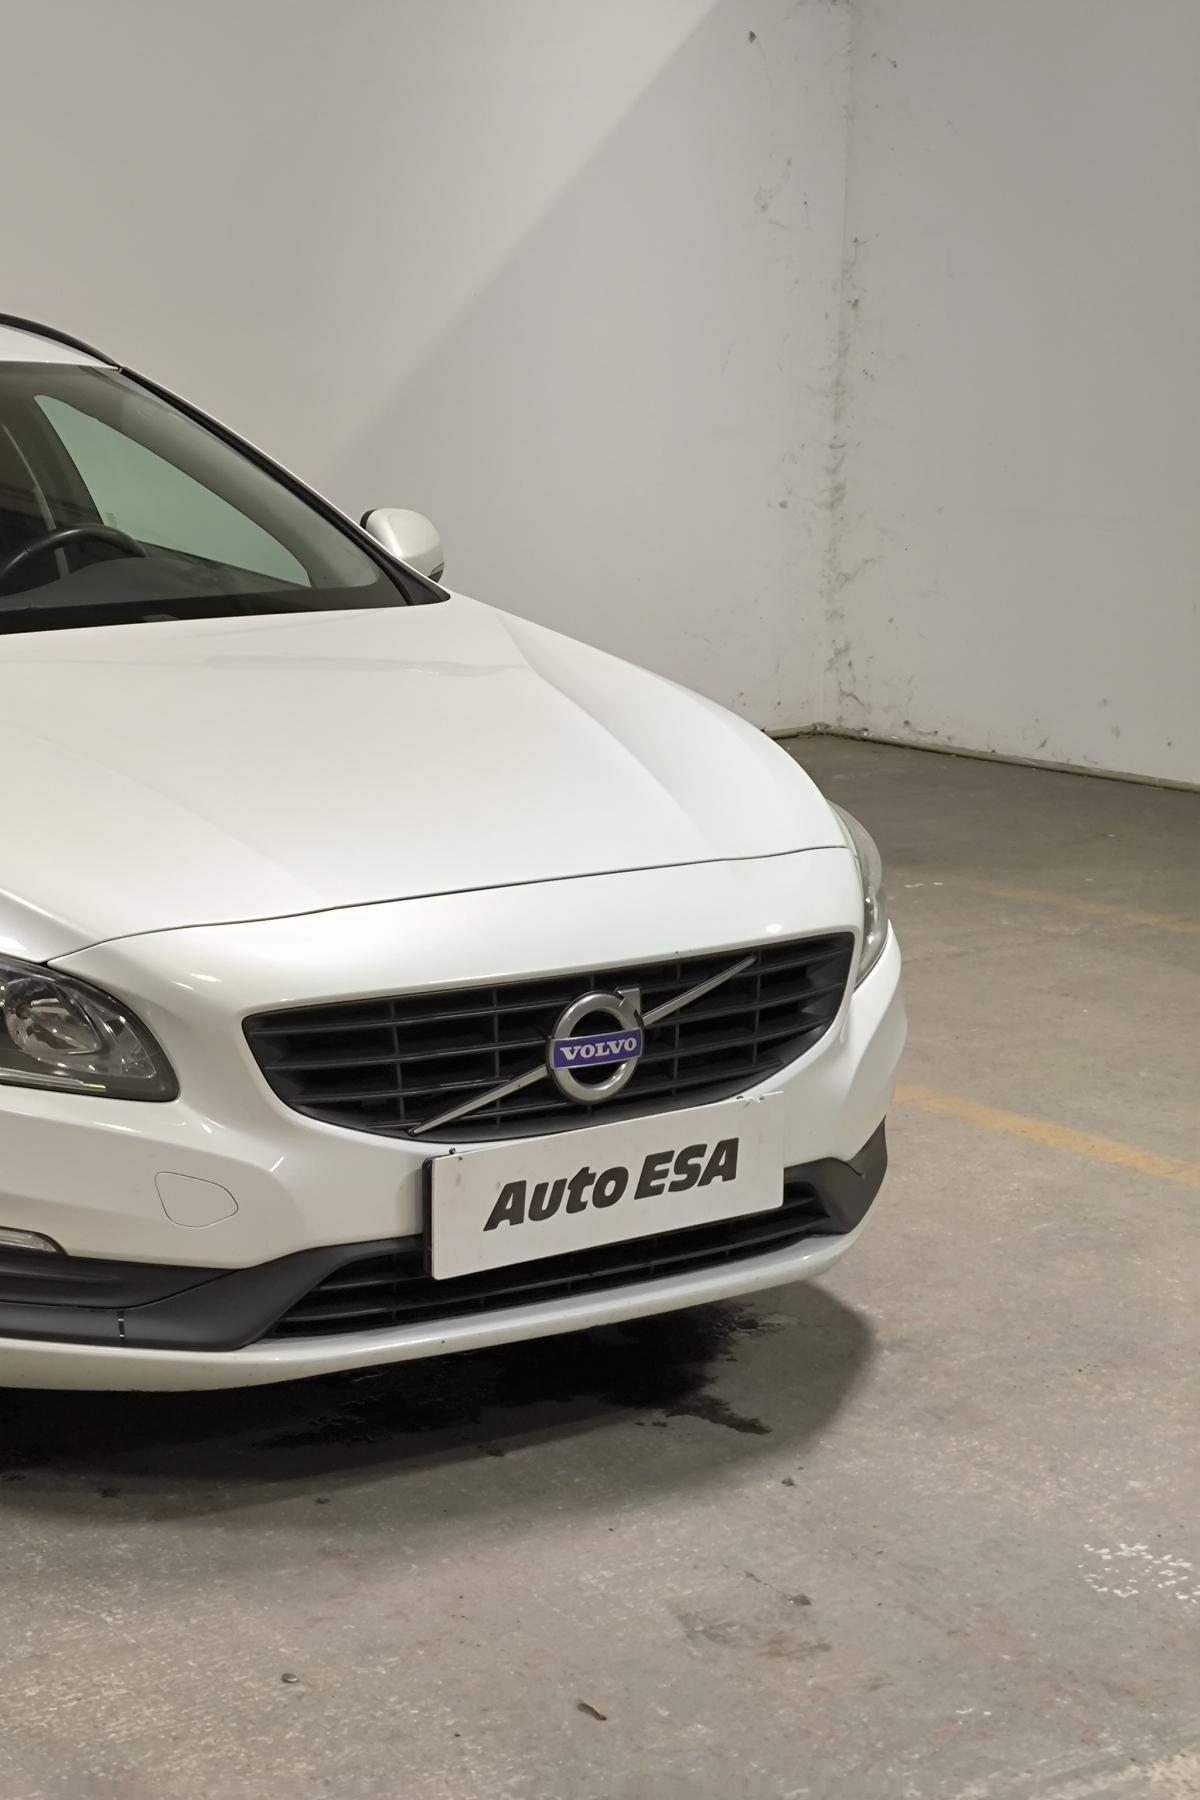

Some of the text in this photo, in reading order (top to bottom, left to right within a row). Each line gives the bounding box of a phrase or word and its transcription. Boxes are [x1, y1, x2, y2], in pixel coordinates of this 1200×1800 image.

[559, 1037, 637, 1061] VOLVO
[482, 1137, 740, 1232] Auto ESA
